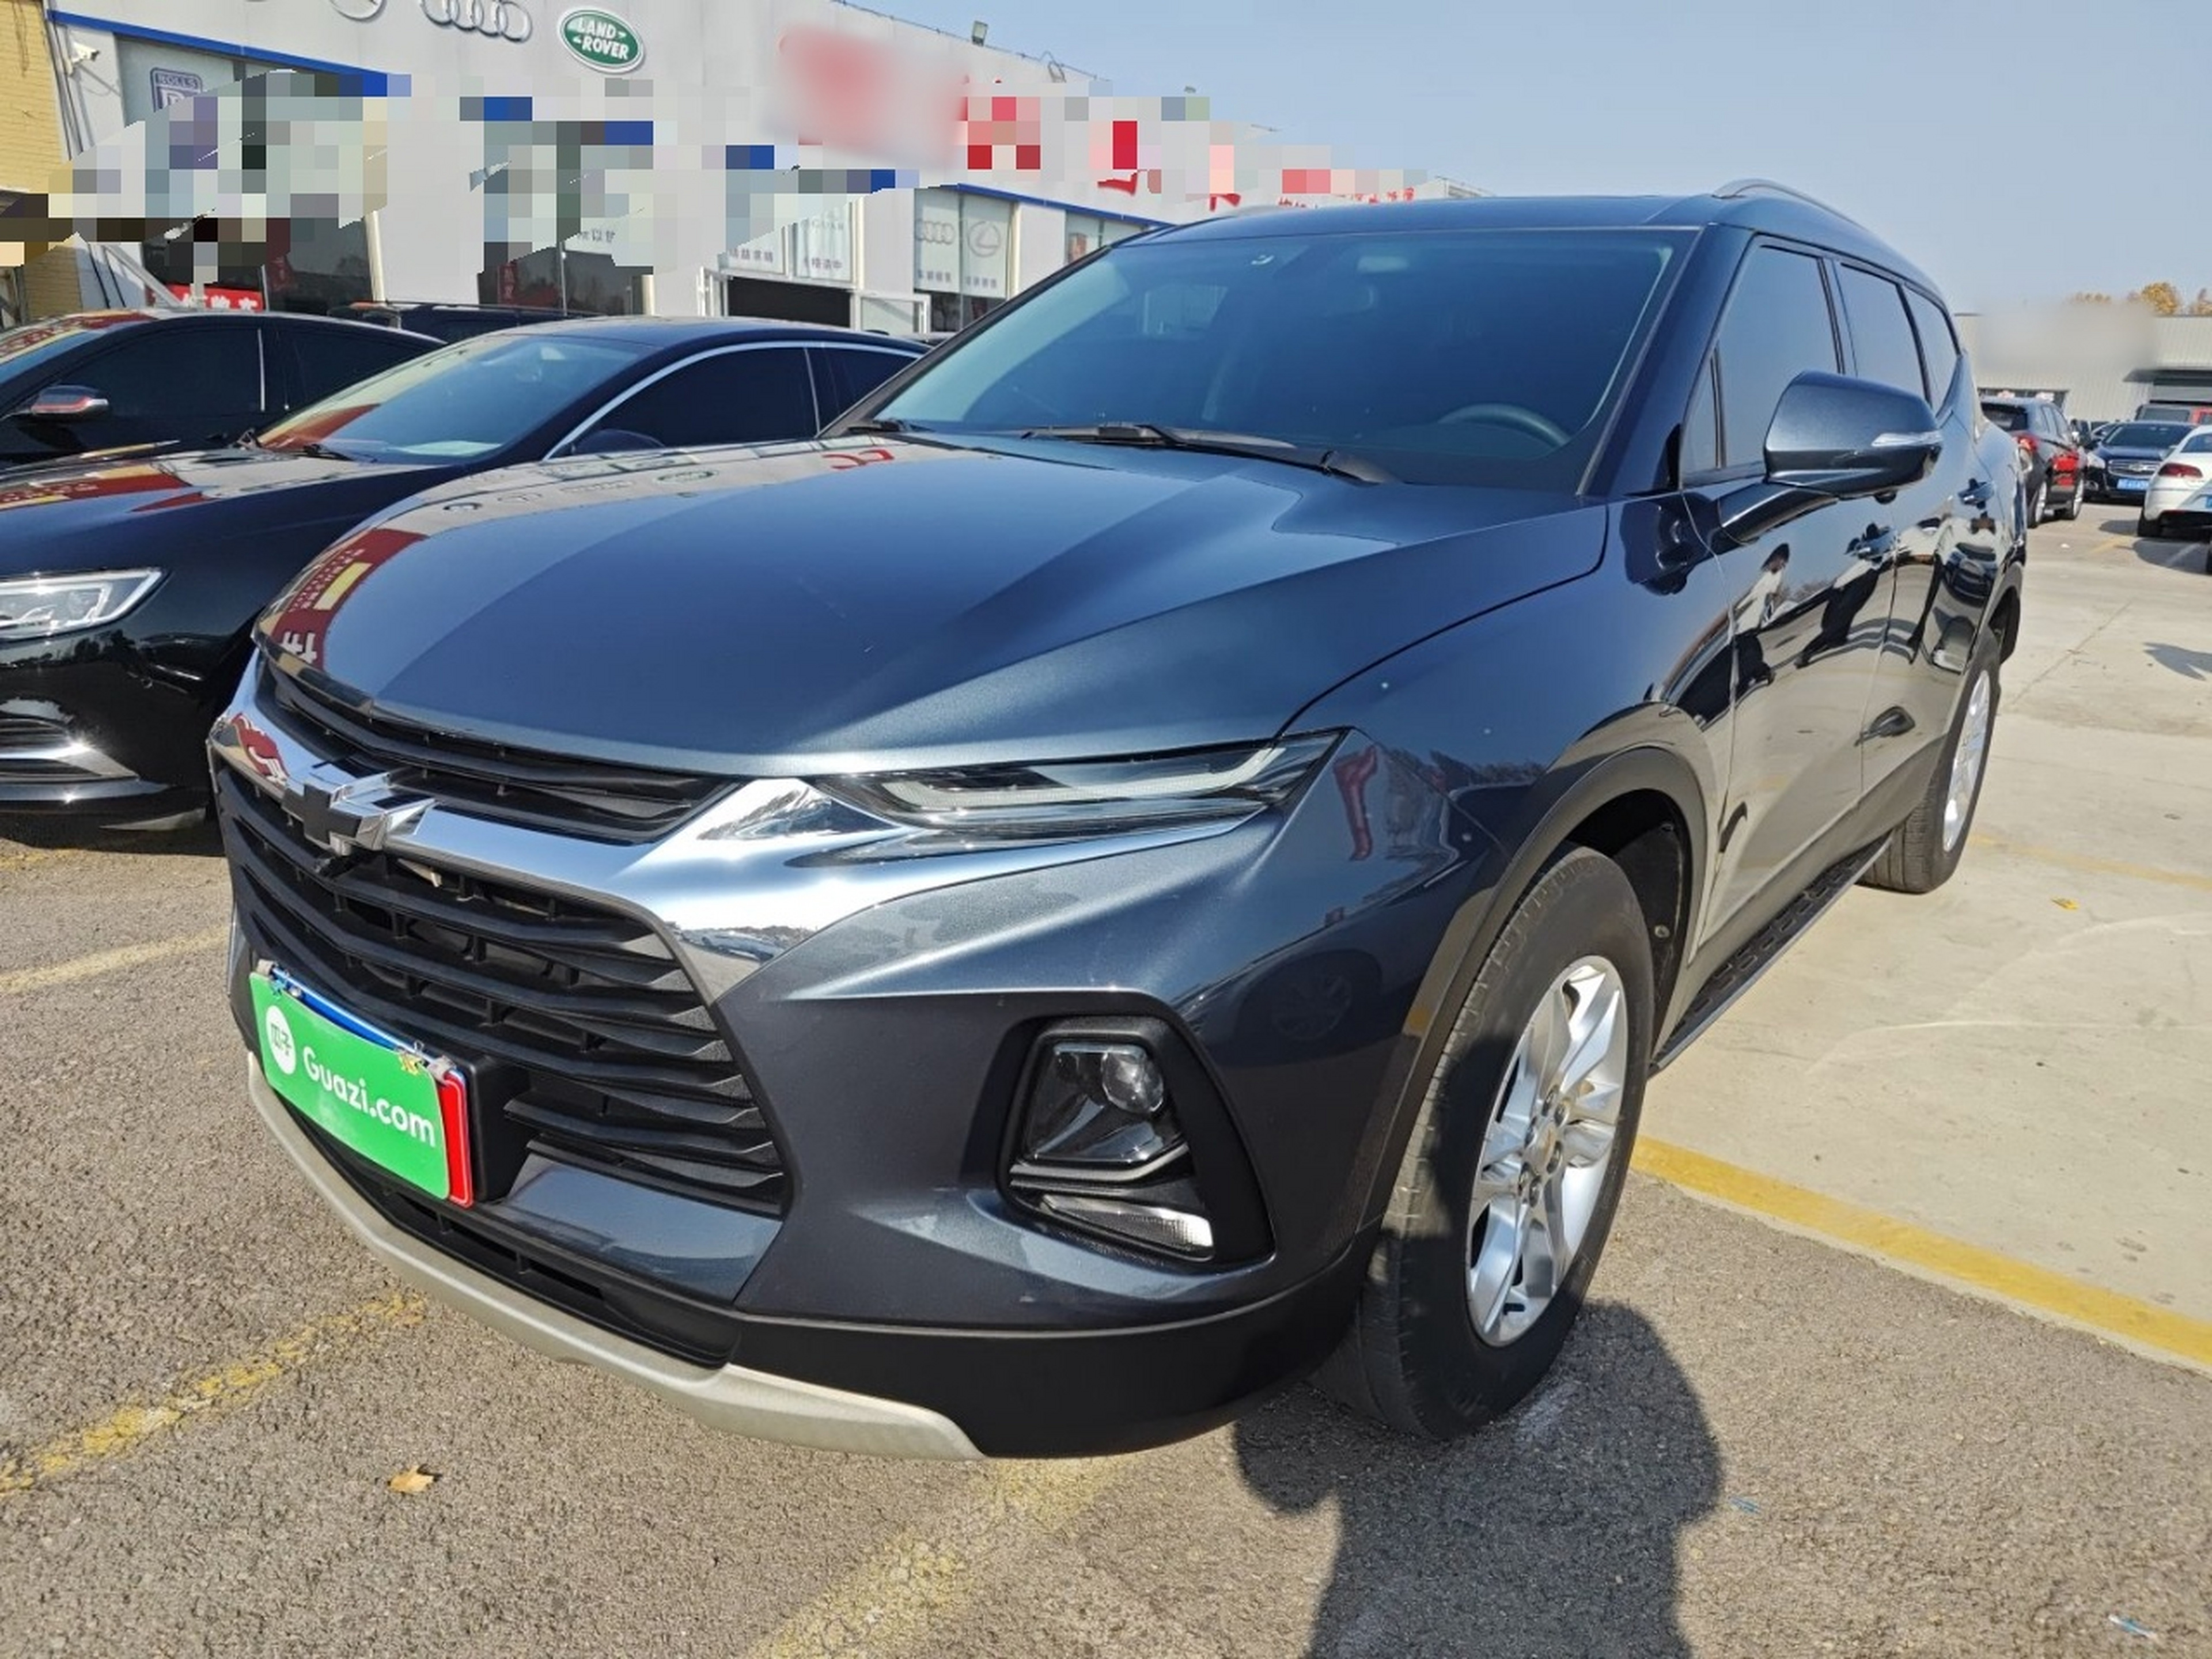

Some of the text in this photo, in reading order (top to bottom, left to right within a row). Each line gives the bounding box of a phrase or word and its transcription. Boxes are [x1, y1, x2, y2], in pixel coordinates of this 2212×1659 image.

[577, 18, 616, 39] LAND
[582, 35, 628, 60] ROVER
[303, 1046, 436, 1147] Guazi.com
